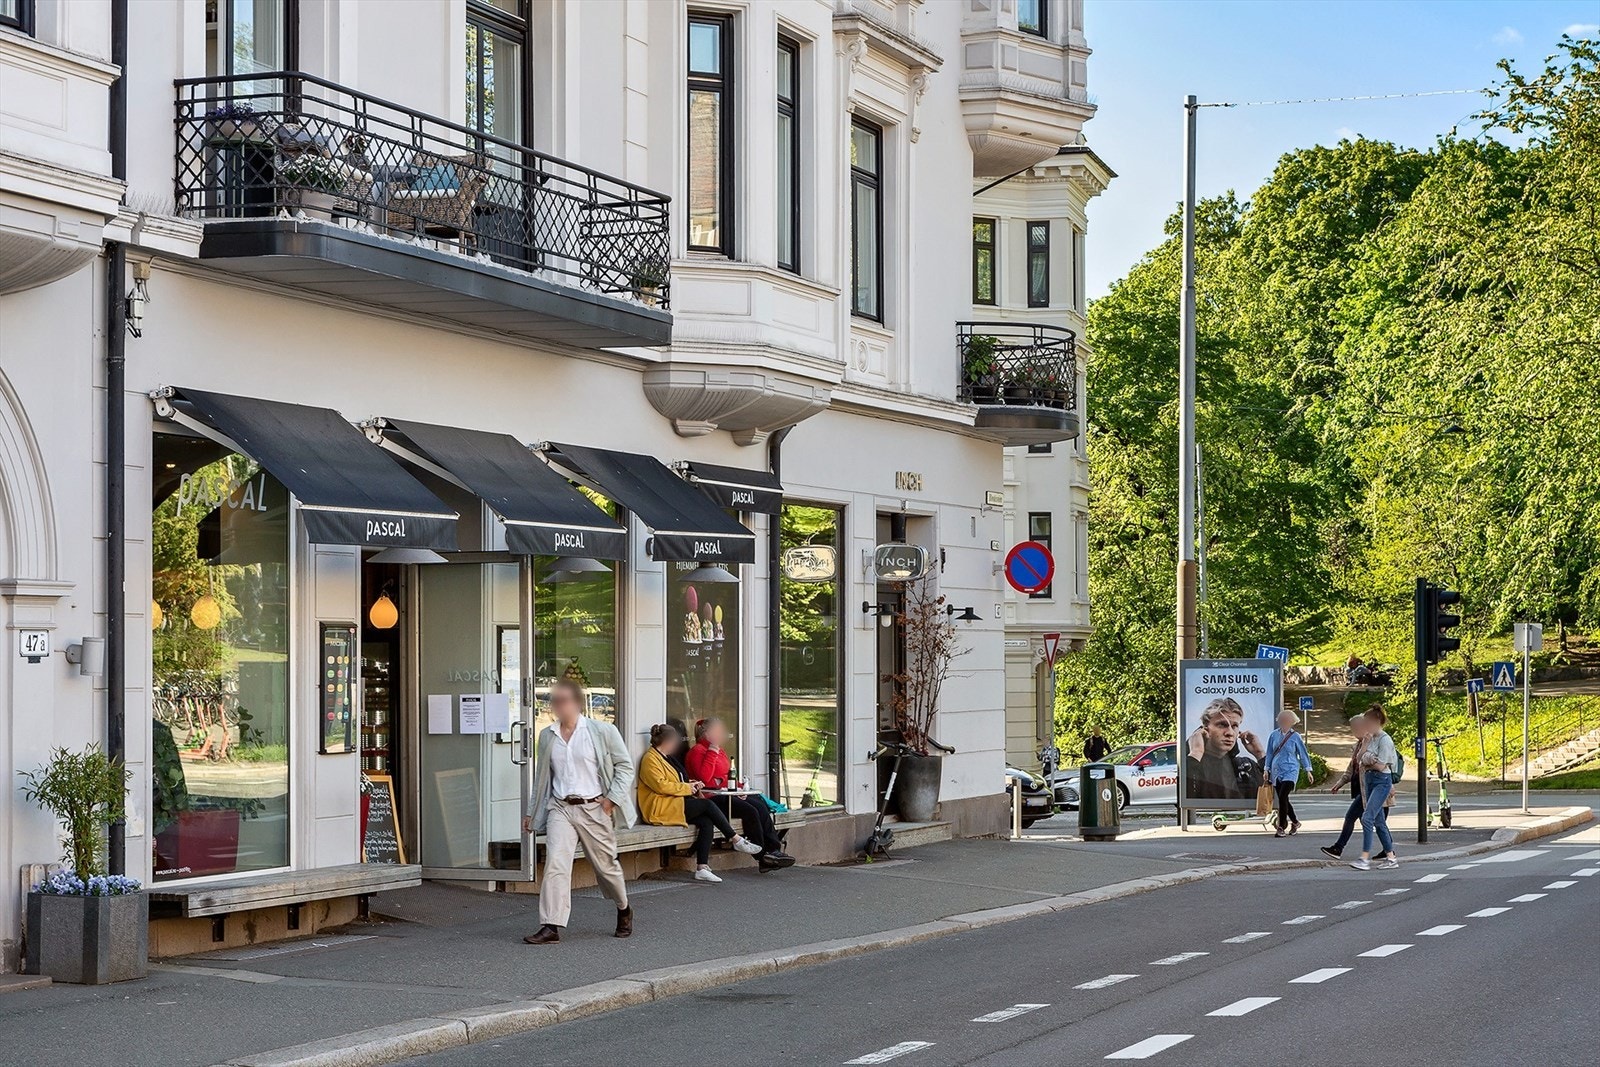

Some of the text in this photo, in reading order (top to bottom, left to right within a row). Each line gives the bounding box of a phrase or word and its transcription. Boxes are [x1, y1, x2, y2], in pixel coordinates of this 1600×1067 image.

[896, 471, 923, 491] INCH
[880, 557, 917, 567] INCH
[1261, 647, 1285, 660] Taxi
[1202, 674, 1258, 684] SAMSUNG
[1194, 686, 1266, 696] Galaxy Buds Pro
[1138, 776, 1178, 787] OsloTax
